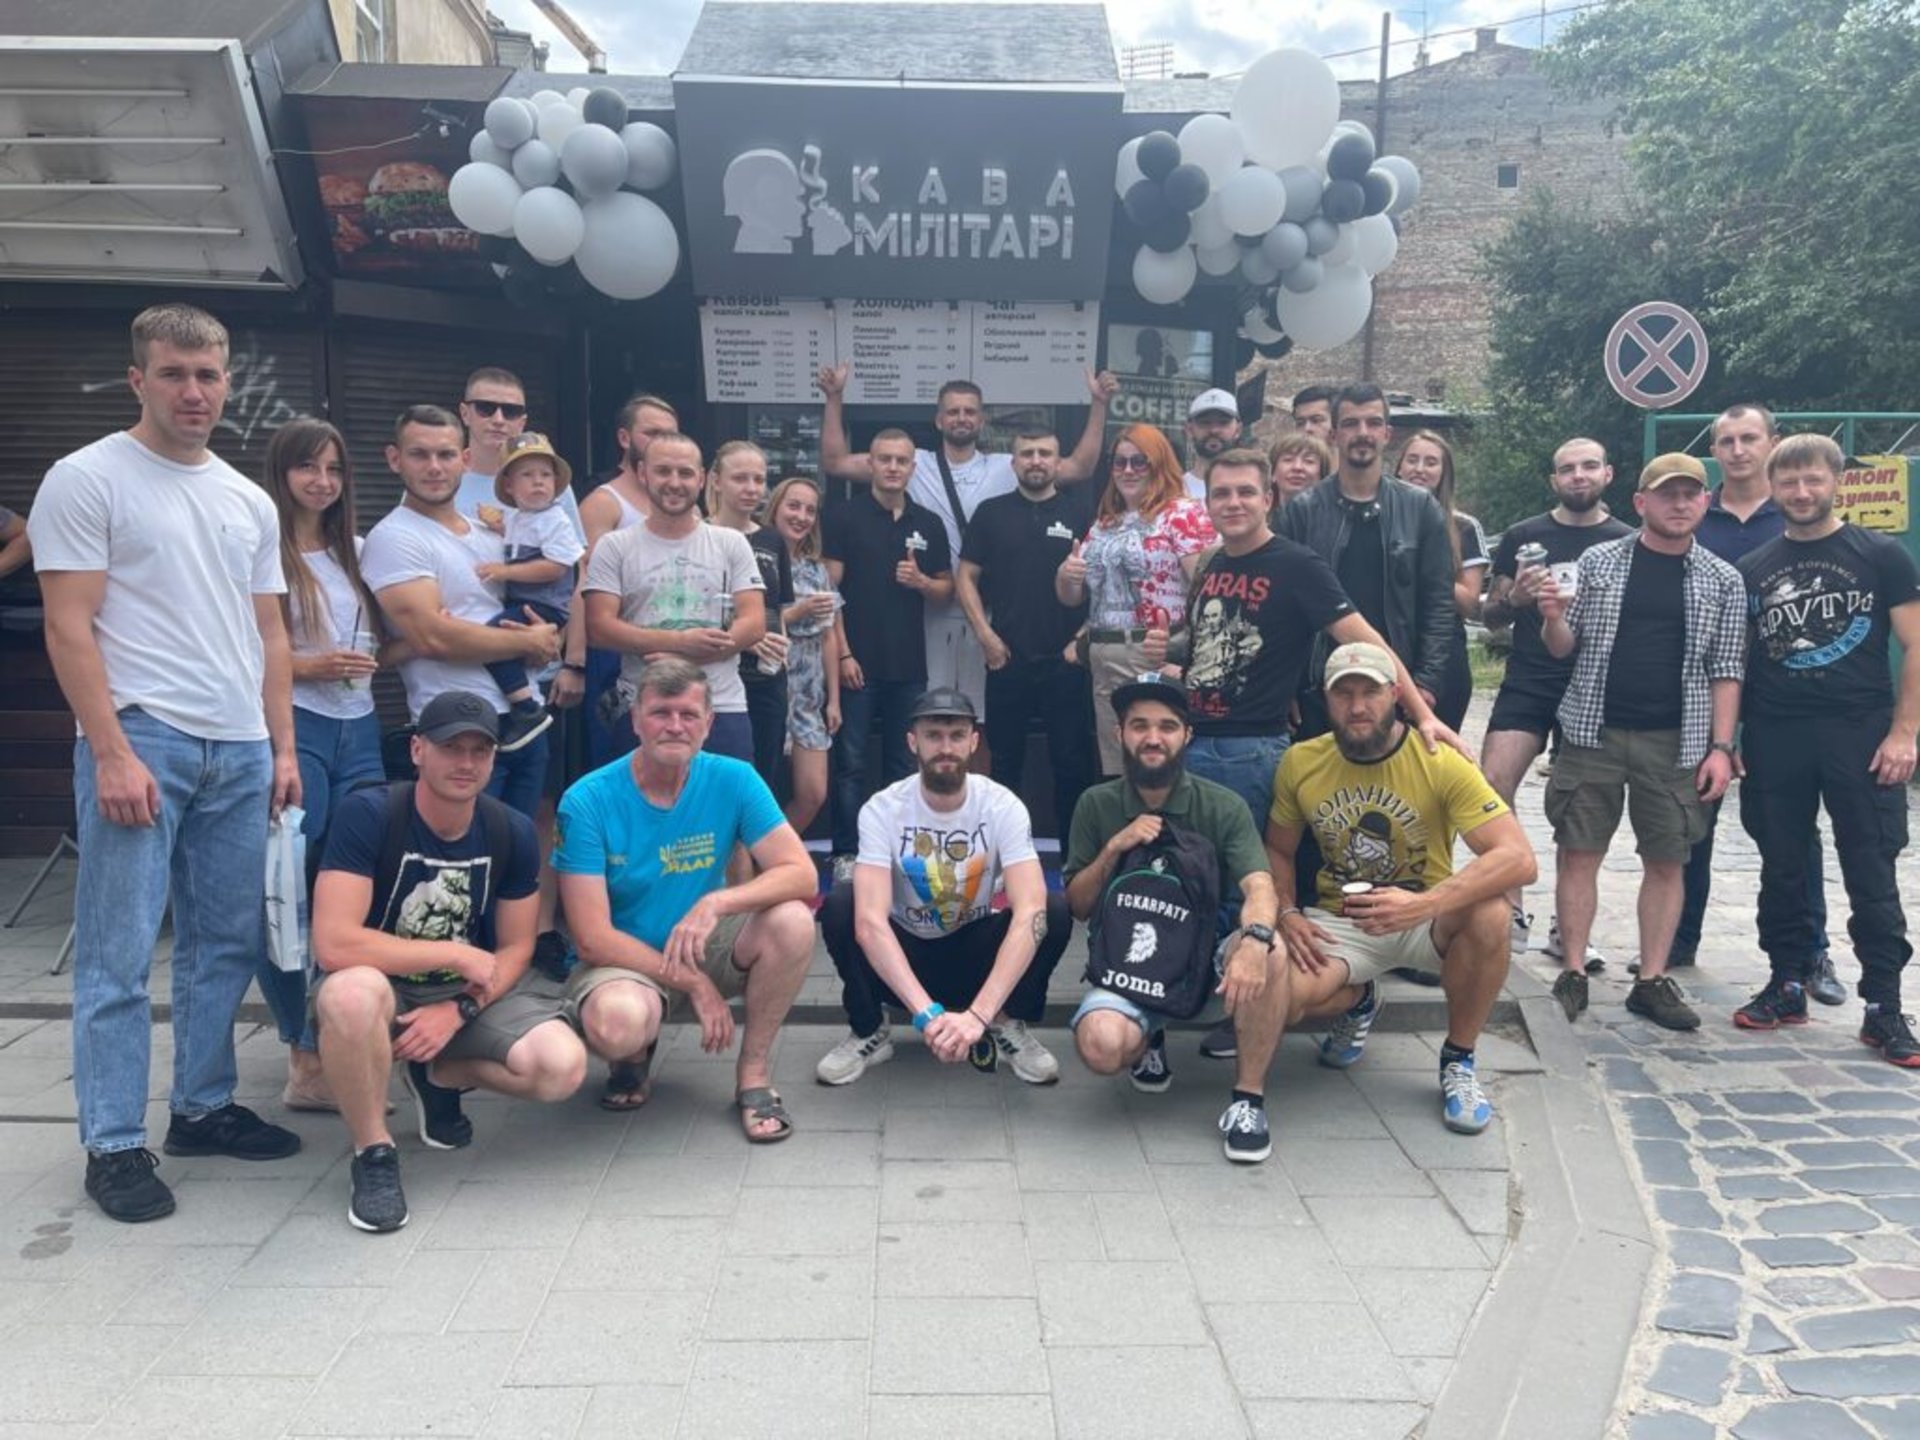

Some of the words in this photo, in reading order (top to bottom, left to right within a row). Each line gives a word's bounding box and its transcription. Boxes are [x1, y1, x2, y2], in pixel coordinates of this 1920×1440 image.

[852, 165, 1076, 207] КАВА
[853, 212, 1074, 260] МІЛІТАРІ
[1110, 393, 1190, 422] COFFE
[1117, 893, 1190, 922] FCKARPATY
